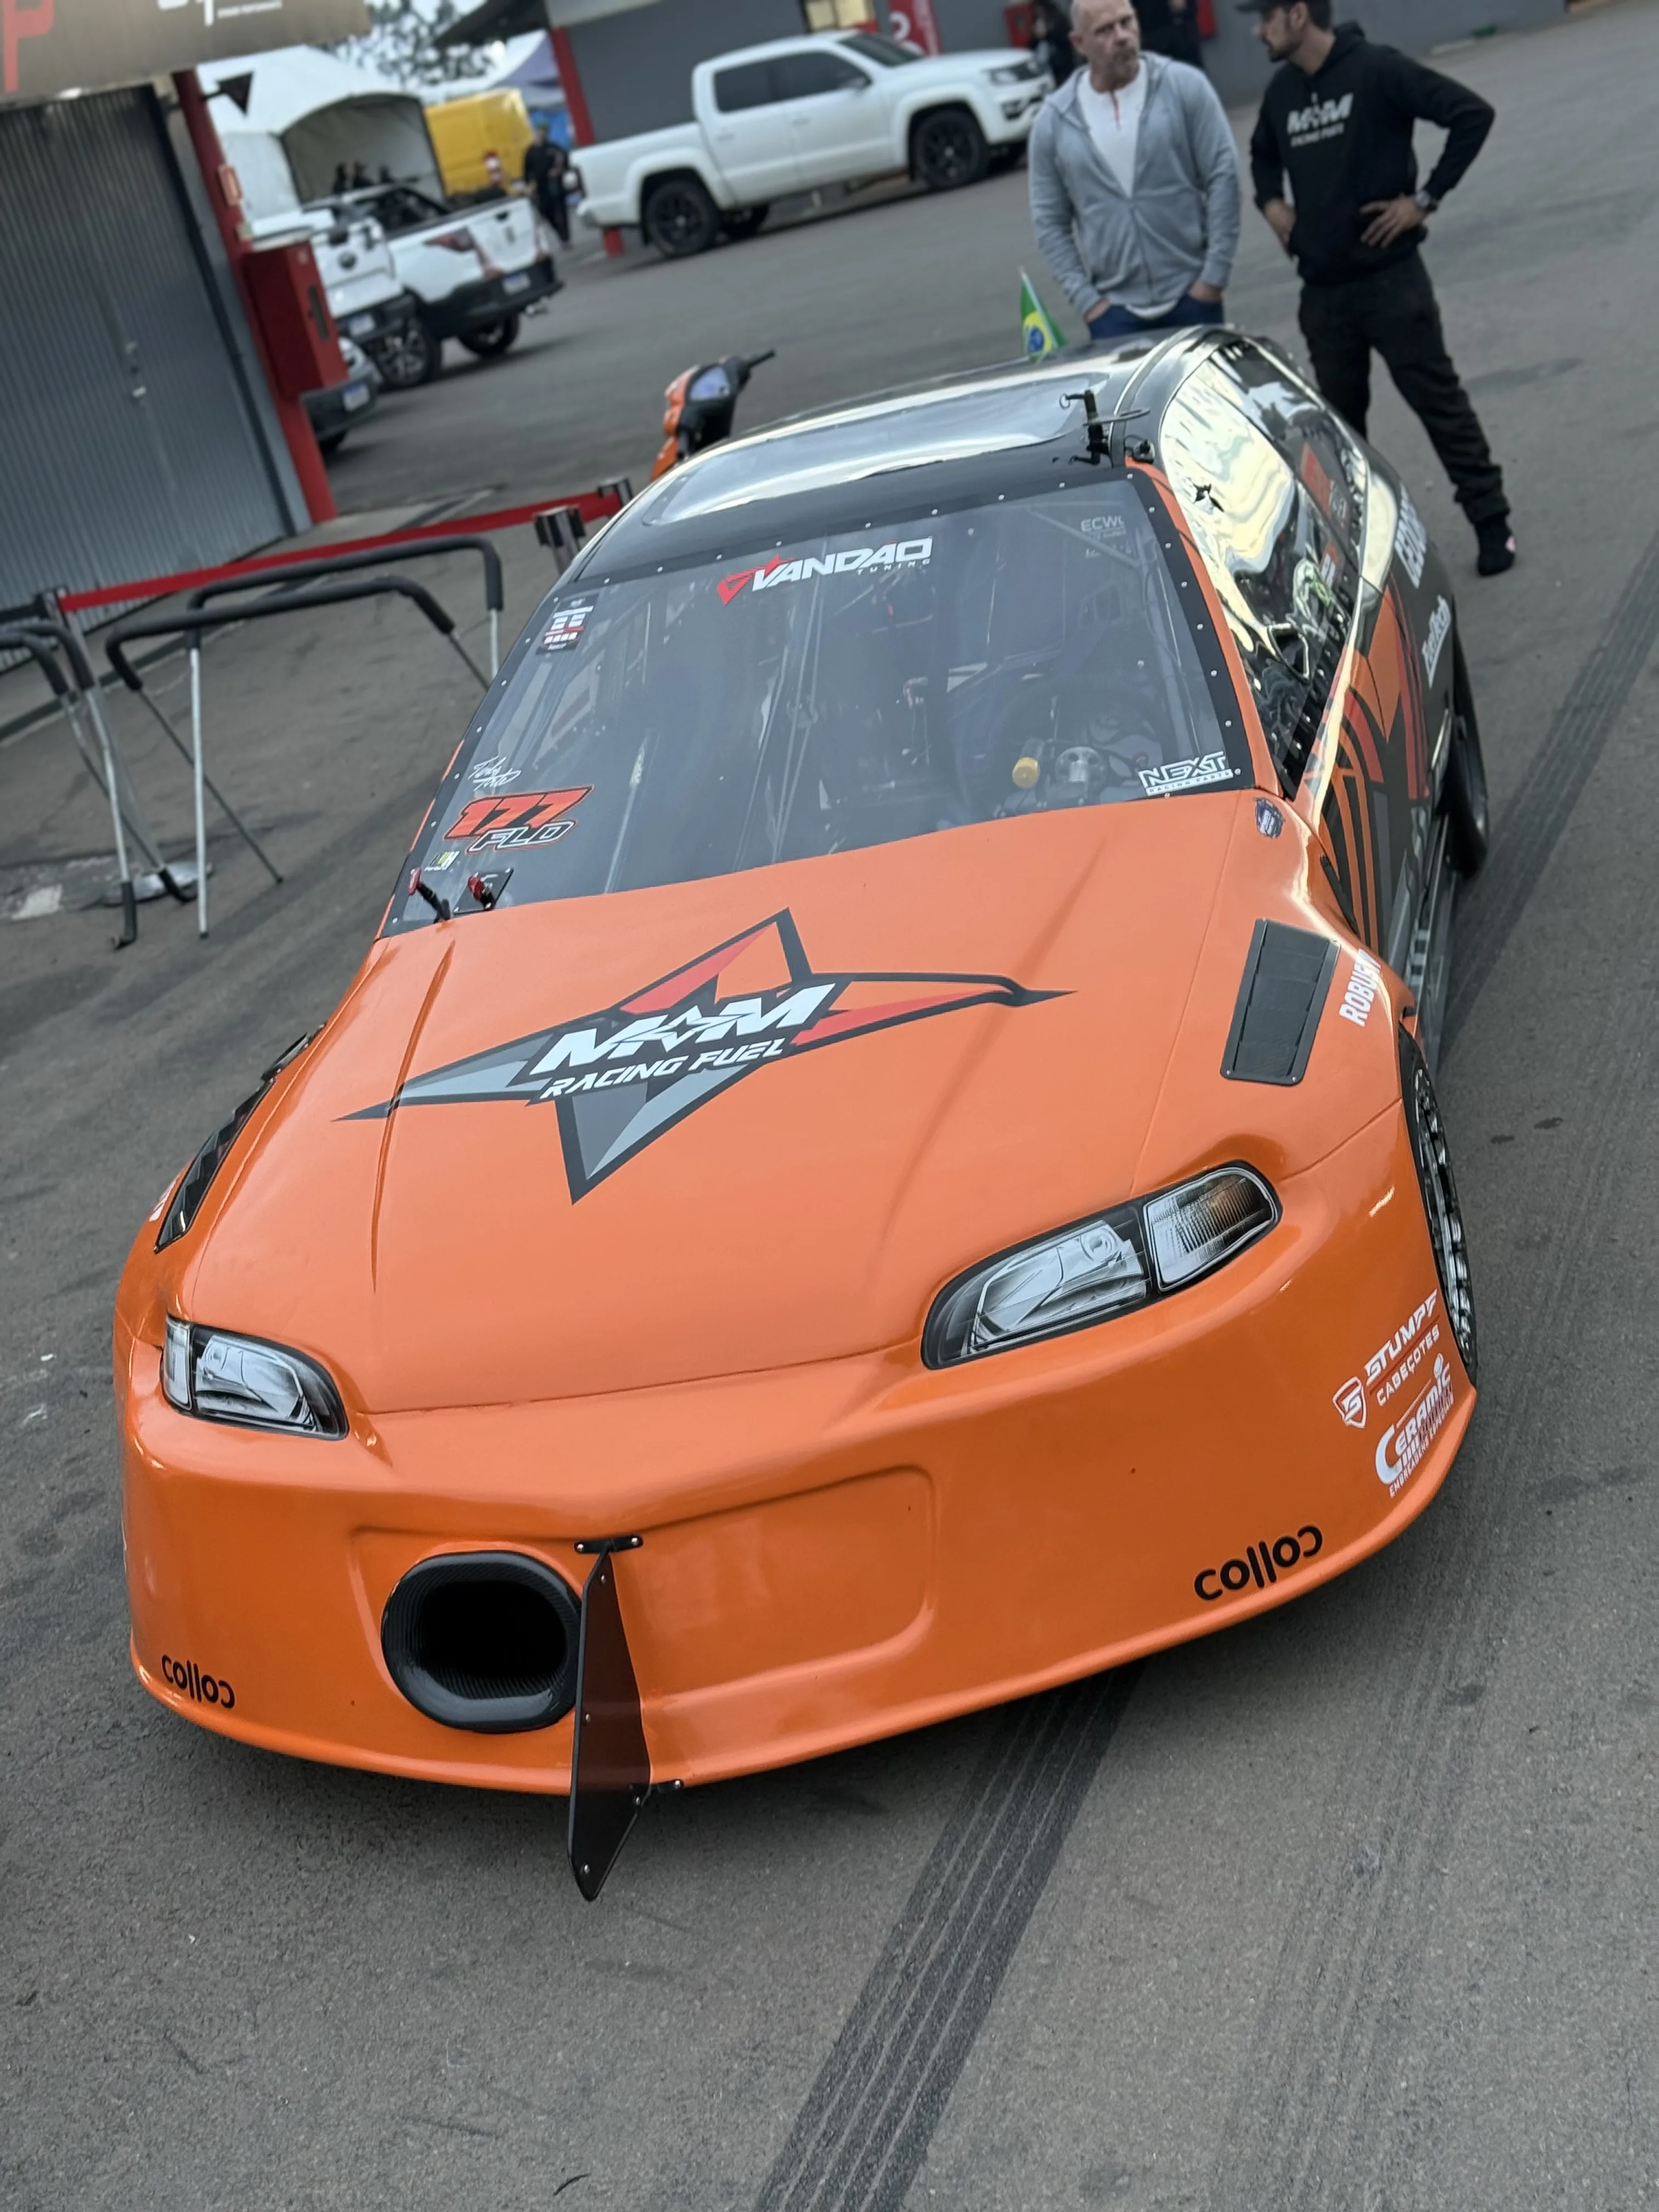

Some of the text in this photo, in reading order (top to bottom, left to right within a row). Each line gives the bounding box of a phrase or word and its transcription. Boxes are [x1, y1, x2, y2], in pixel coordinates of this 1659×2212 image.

[857, 558, 930, 575] TUNING
[1149, 771, 1230, 793] RACING PARTS
[539, 1037, 788, 1101] RACING FUEL
[1364, 1288, 1438, 1387] STUMPF
